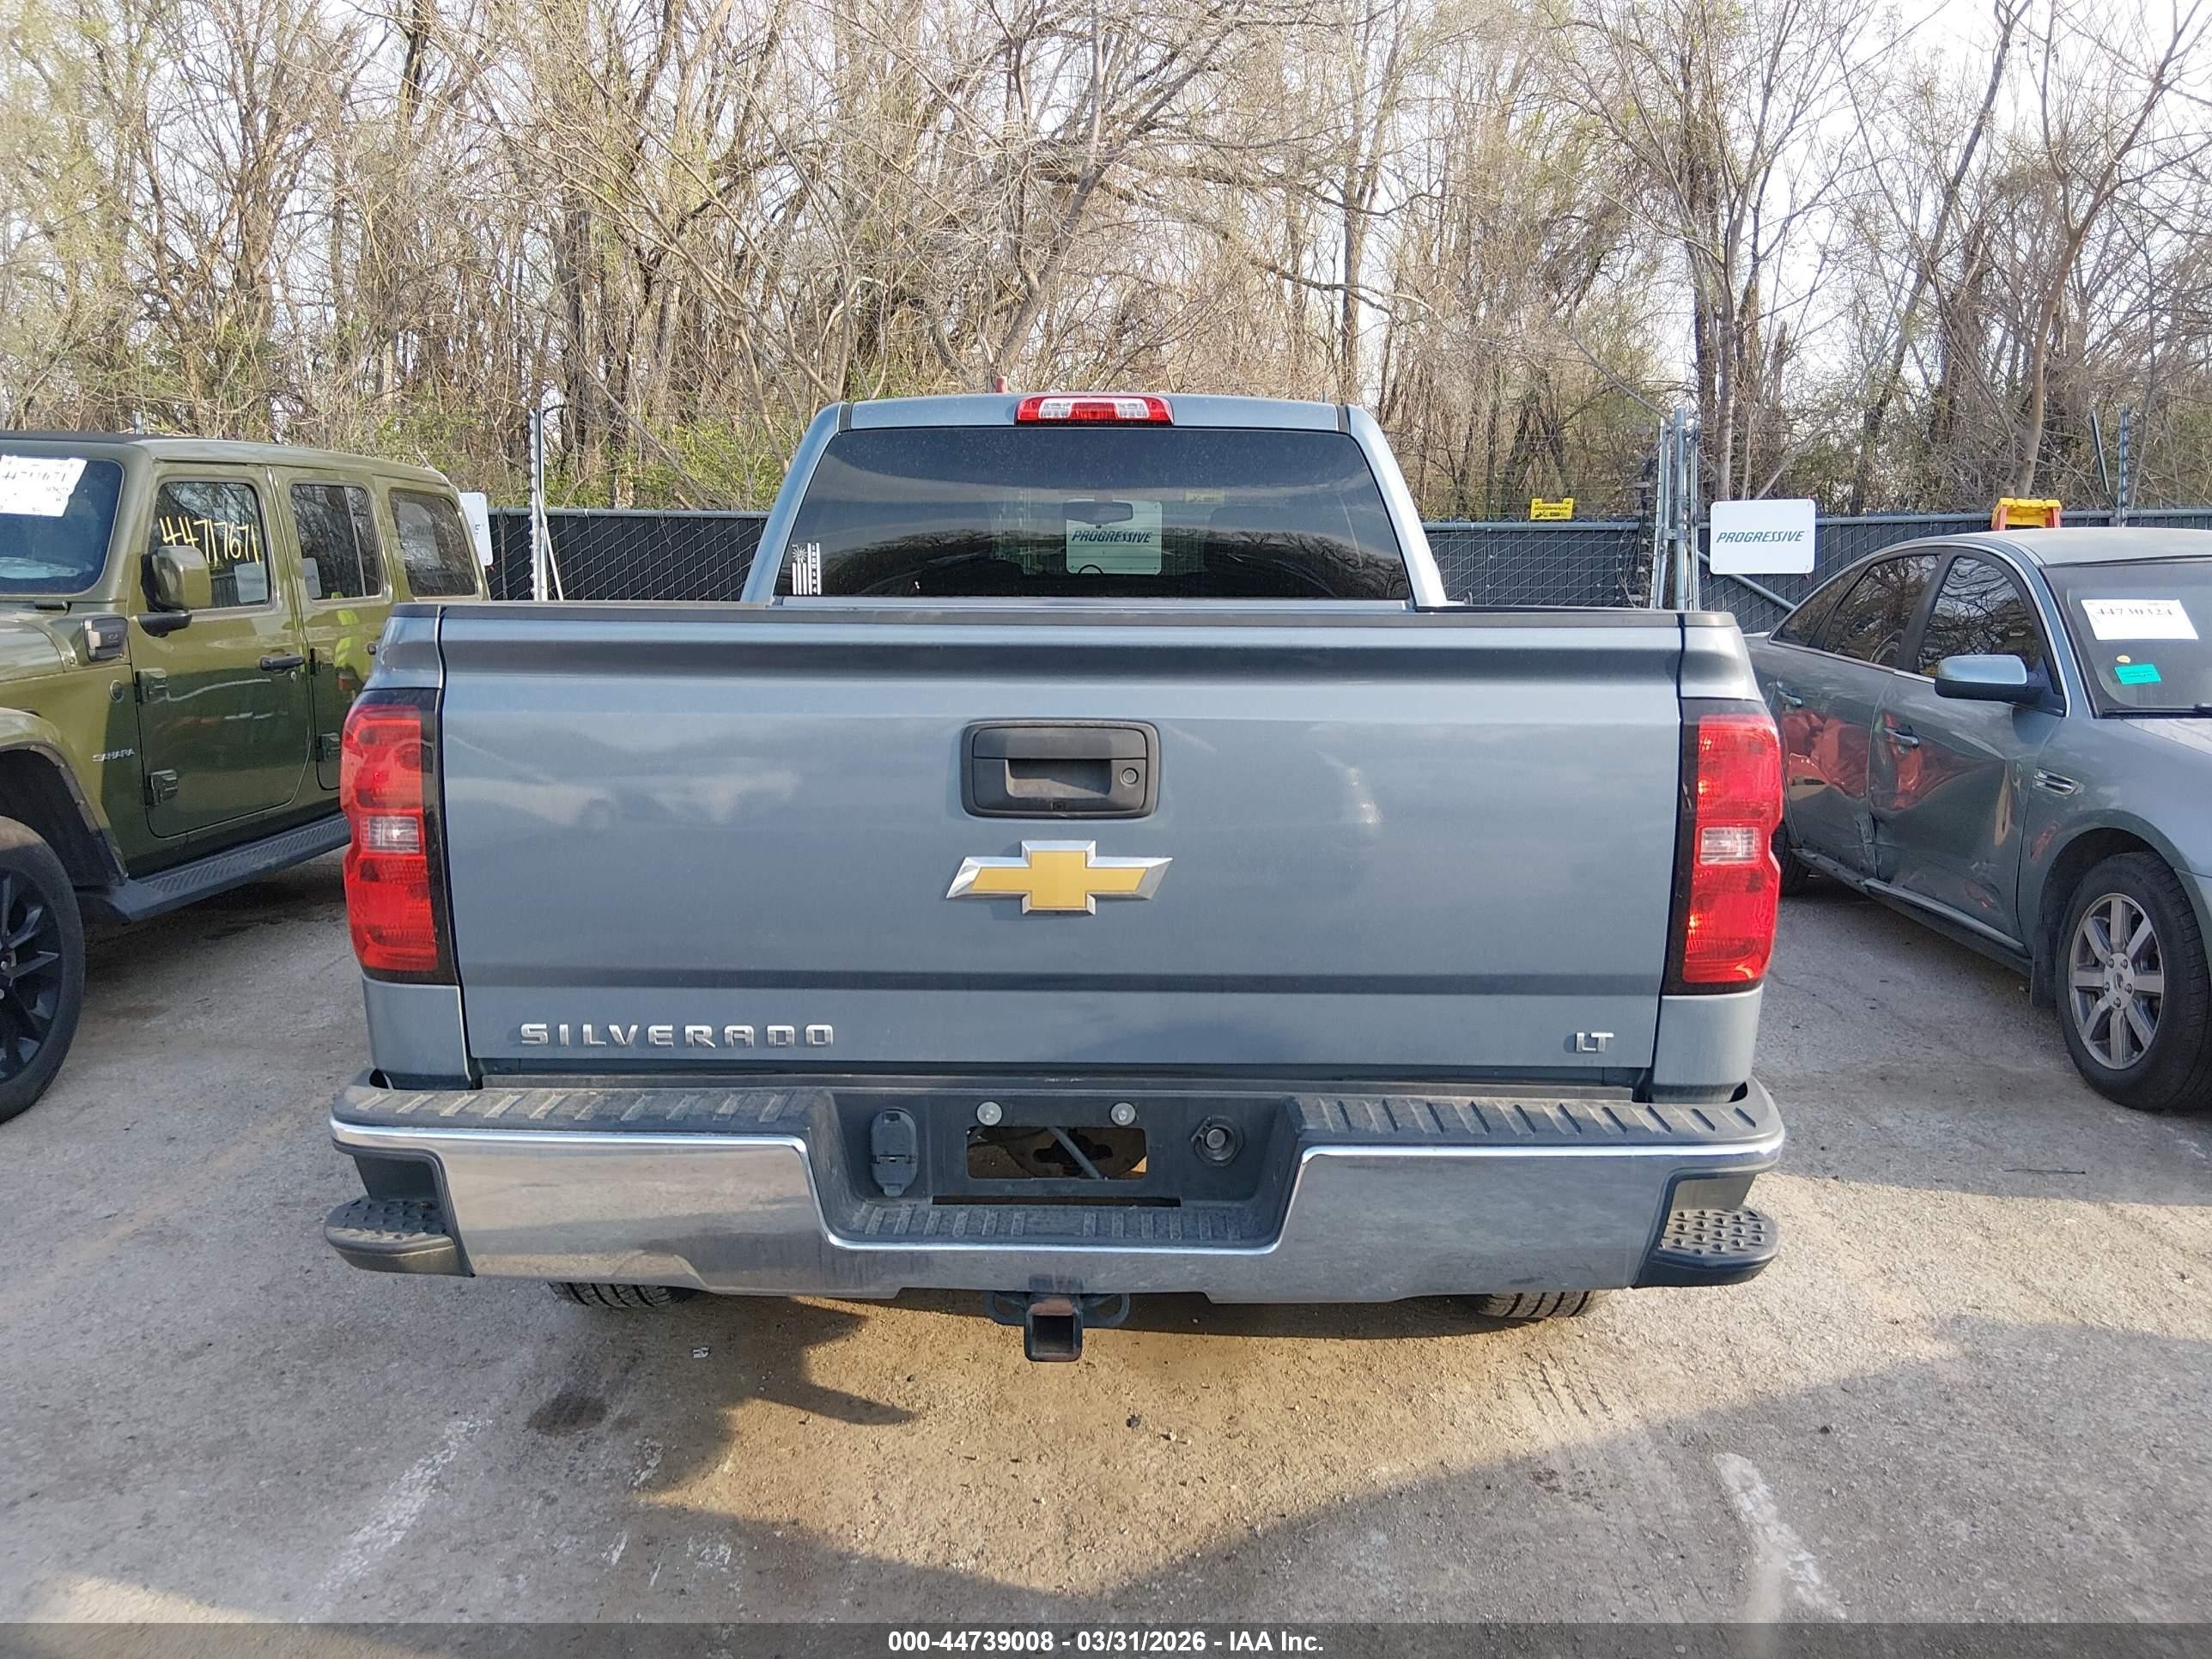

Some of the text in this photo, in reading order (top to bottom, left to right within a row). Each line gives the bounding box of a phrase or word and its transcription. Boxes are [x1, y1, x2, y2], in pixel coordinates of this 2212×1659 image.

[159, 516, 259, 566] 44717671
[1071, 530, 1152, 544] PROGRESSIVE
[1716, 530, 1806, 544] PROGRESSIVE
[93, 748, 135, 763] SAHARA
[520, 1023, 834, 1048] SILVERADO
[1576, 1031, 1614, 1053] LT
